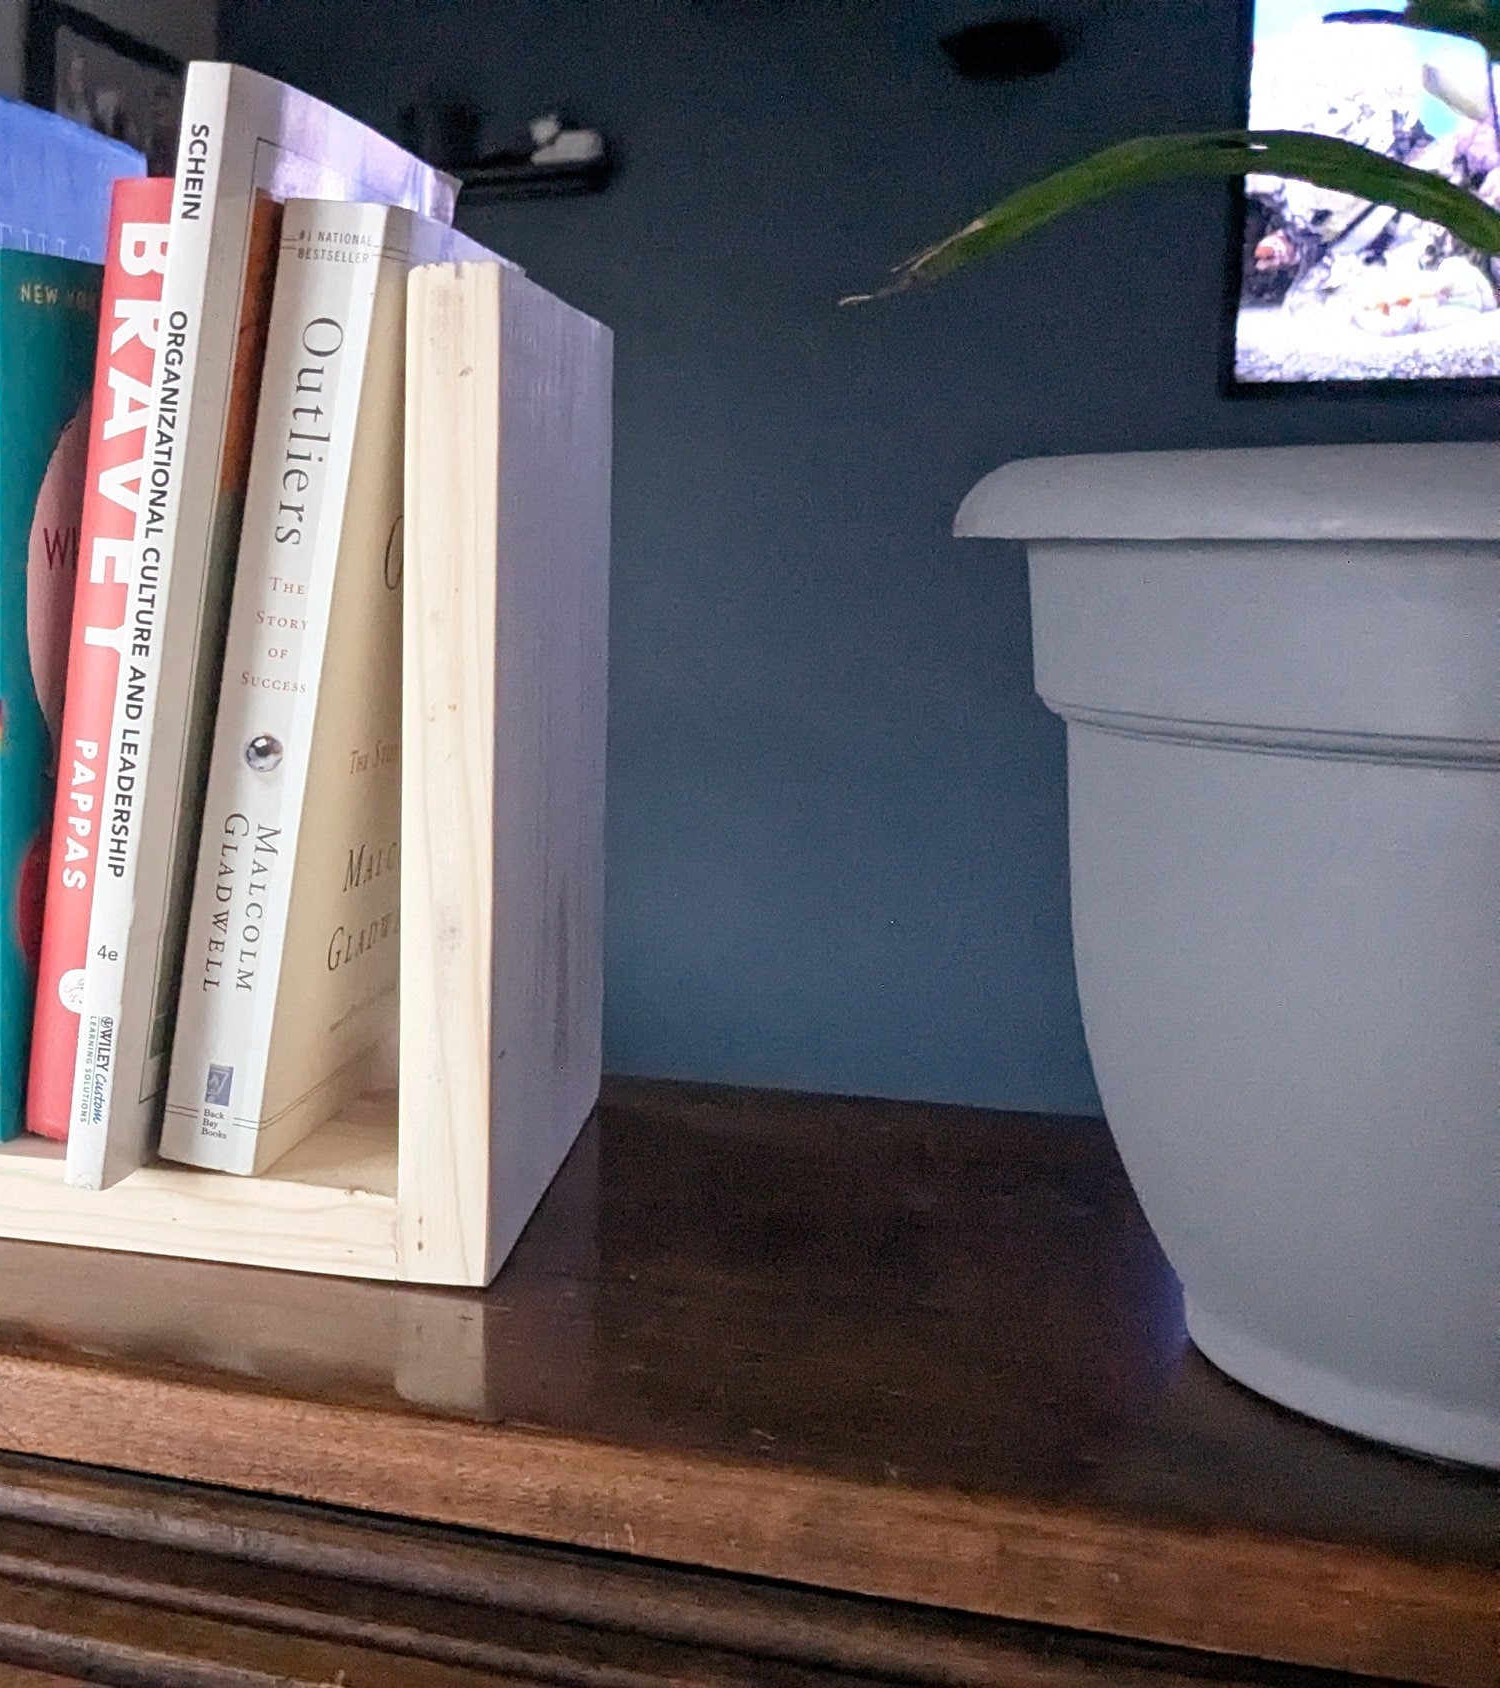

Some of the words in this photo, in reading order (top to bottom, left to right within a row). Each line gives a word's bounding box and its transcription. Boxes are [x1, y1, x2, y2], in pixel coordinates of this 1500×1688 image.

[181, 124, 209, 221] SCHEIN
[298, 248, 369, 264] BESTSELLER
[317, 232, 373, 247] NATIONAL
[20, 282, 59, 305] NEW
[145, 311, 188, 539] ORGANIZATIONAL
[275, 317, 344, 546] Outliers
[132, 547, 161, 658] CULTURE
[125, 665, 147, 721] AND
[62, 739, 99, 890] PAPPAS
[108, 728, 141, 879] LEADERSHIP
[202, 812, 249, 993] GLADWELL
[235, 824, 282, 992] MALCOLM
[97, 945, 118, 961] 4e
[86, 1016, 98, 1065] LEARNING
[97, 1026, 114, 1073] WILEY
[80, 1068, 92, 1123] SOLUTIONS
[92, 1072, 108, 1125] Custom
[204, 1108, 225, 1120] Back
[201, 1127, 227, 1139] Books
[202, 1117, 219, 1129] Bay
